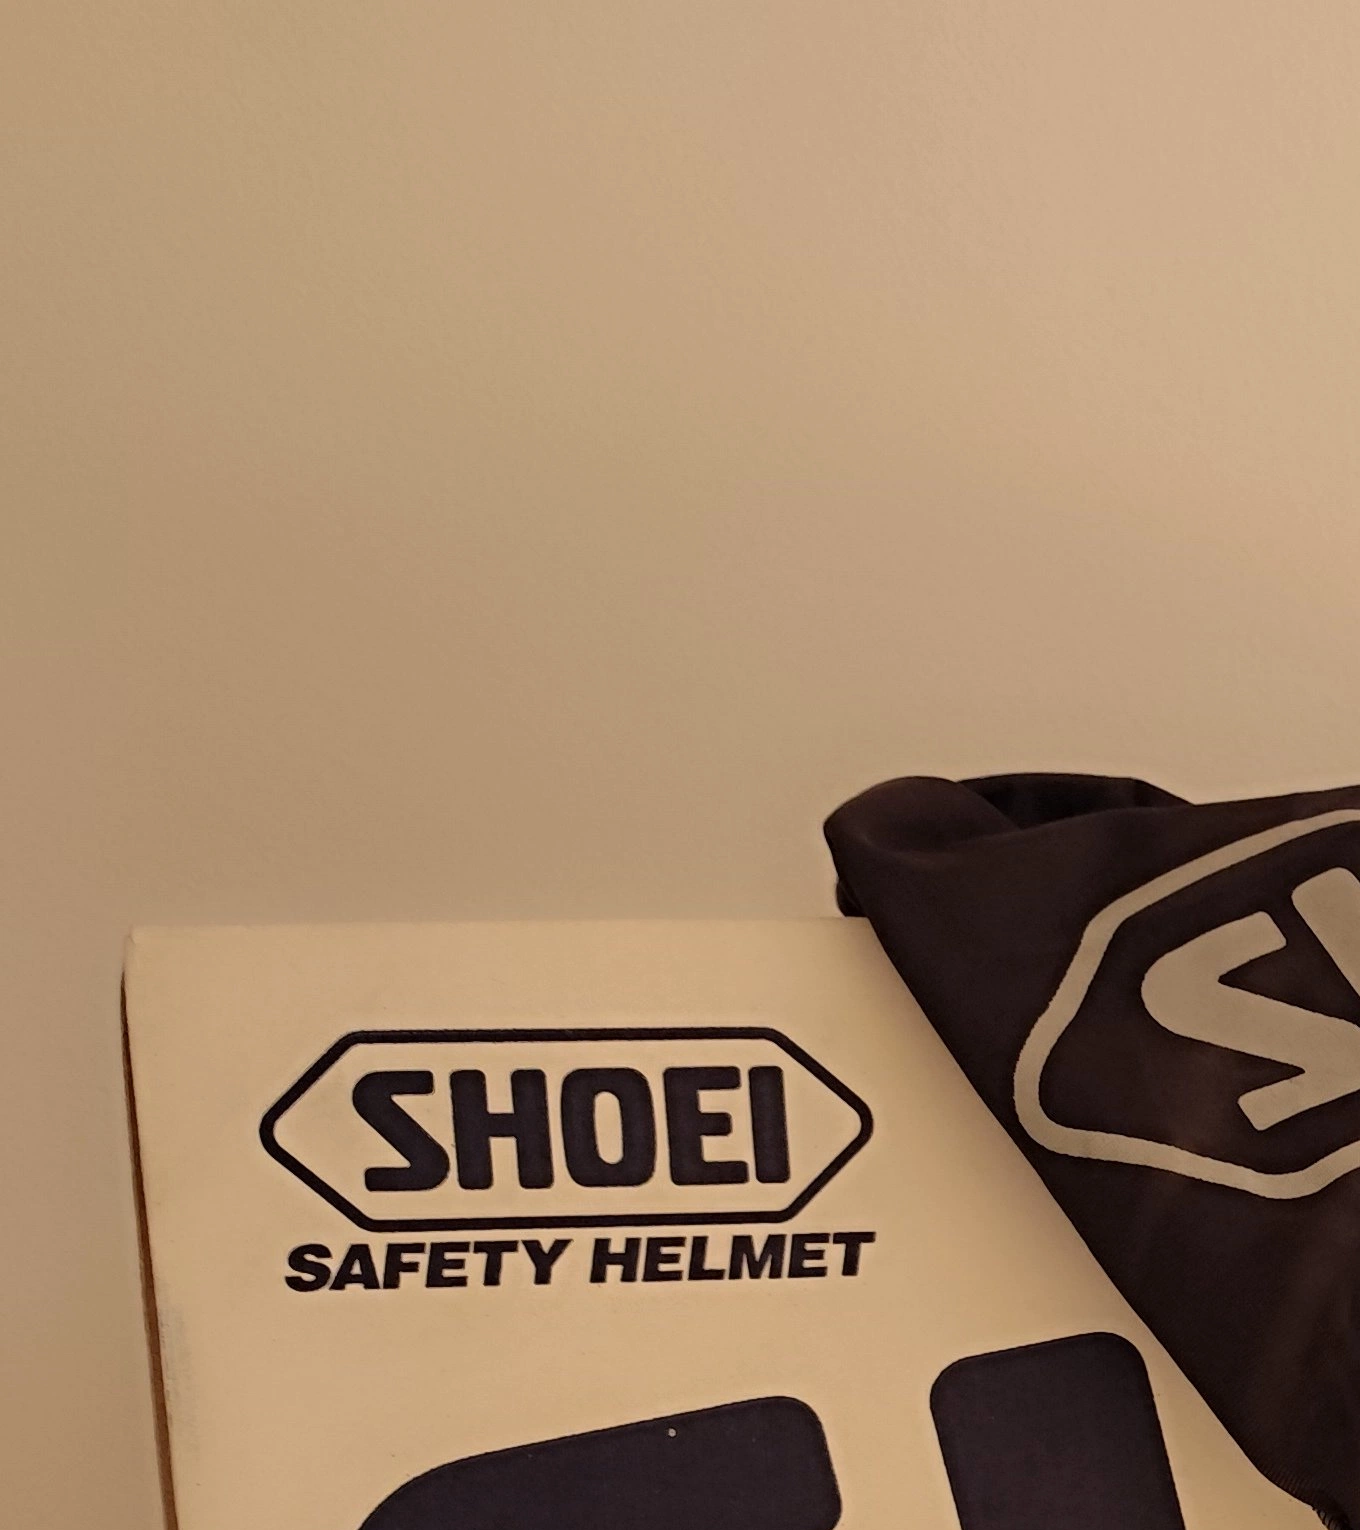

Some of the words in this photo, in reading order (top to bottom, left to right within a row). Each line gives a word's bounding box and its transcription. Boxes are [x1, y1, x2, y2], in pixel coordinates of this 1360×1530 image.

[351, 1065, 791, 1192] SHOEI
[284, 1237, 573, 1292] SAFETY
[589, 1230, 876, 1284] HELMET
